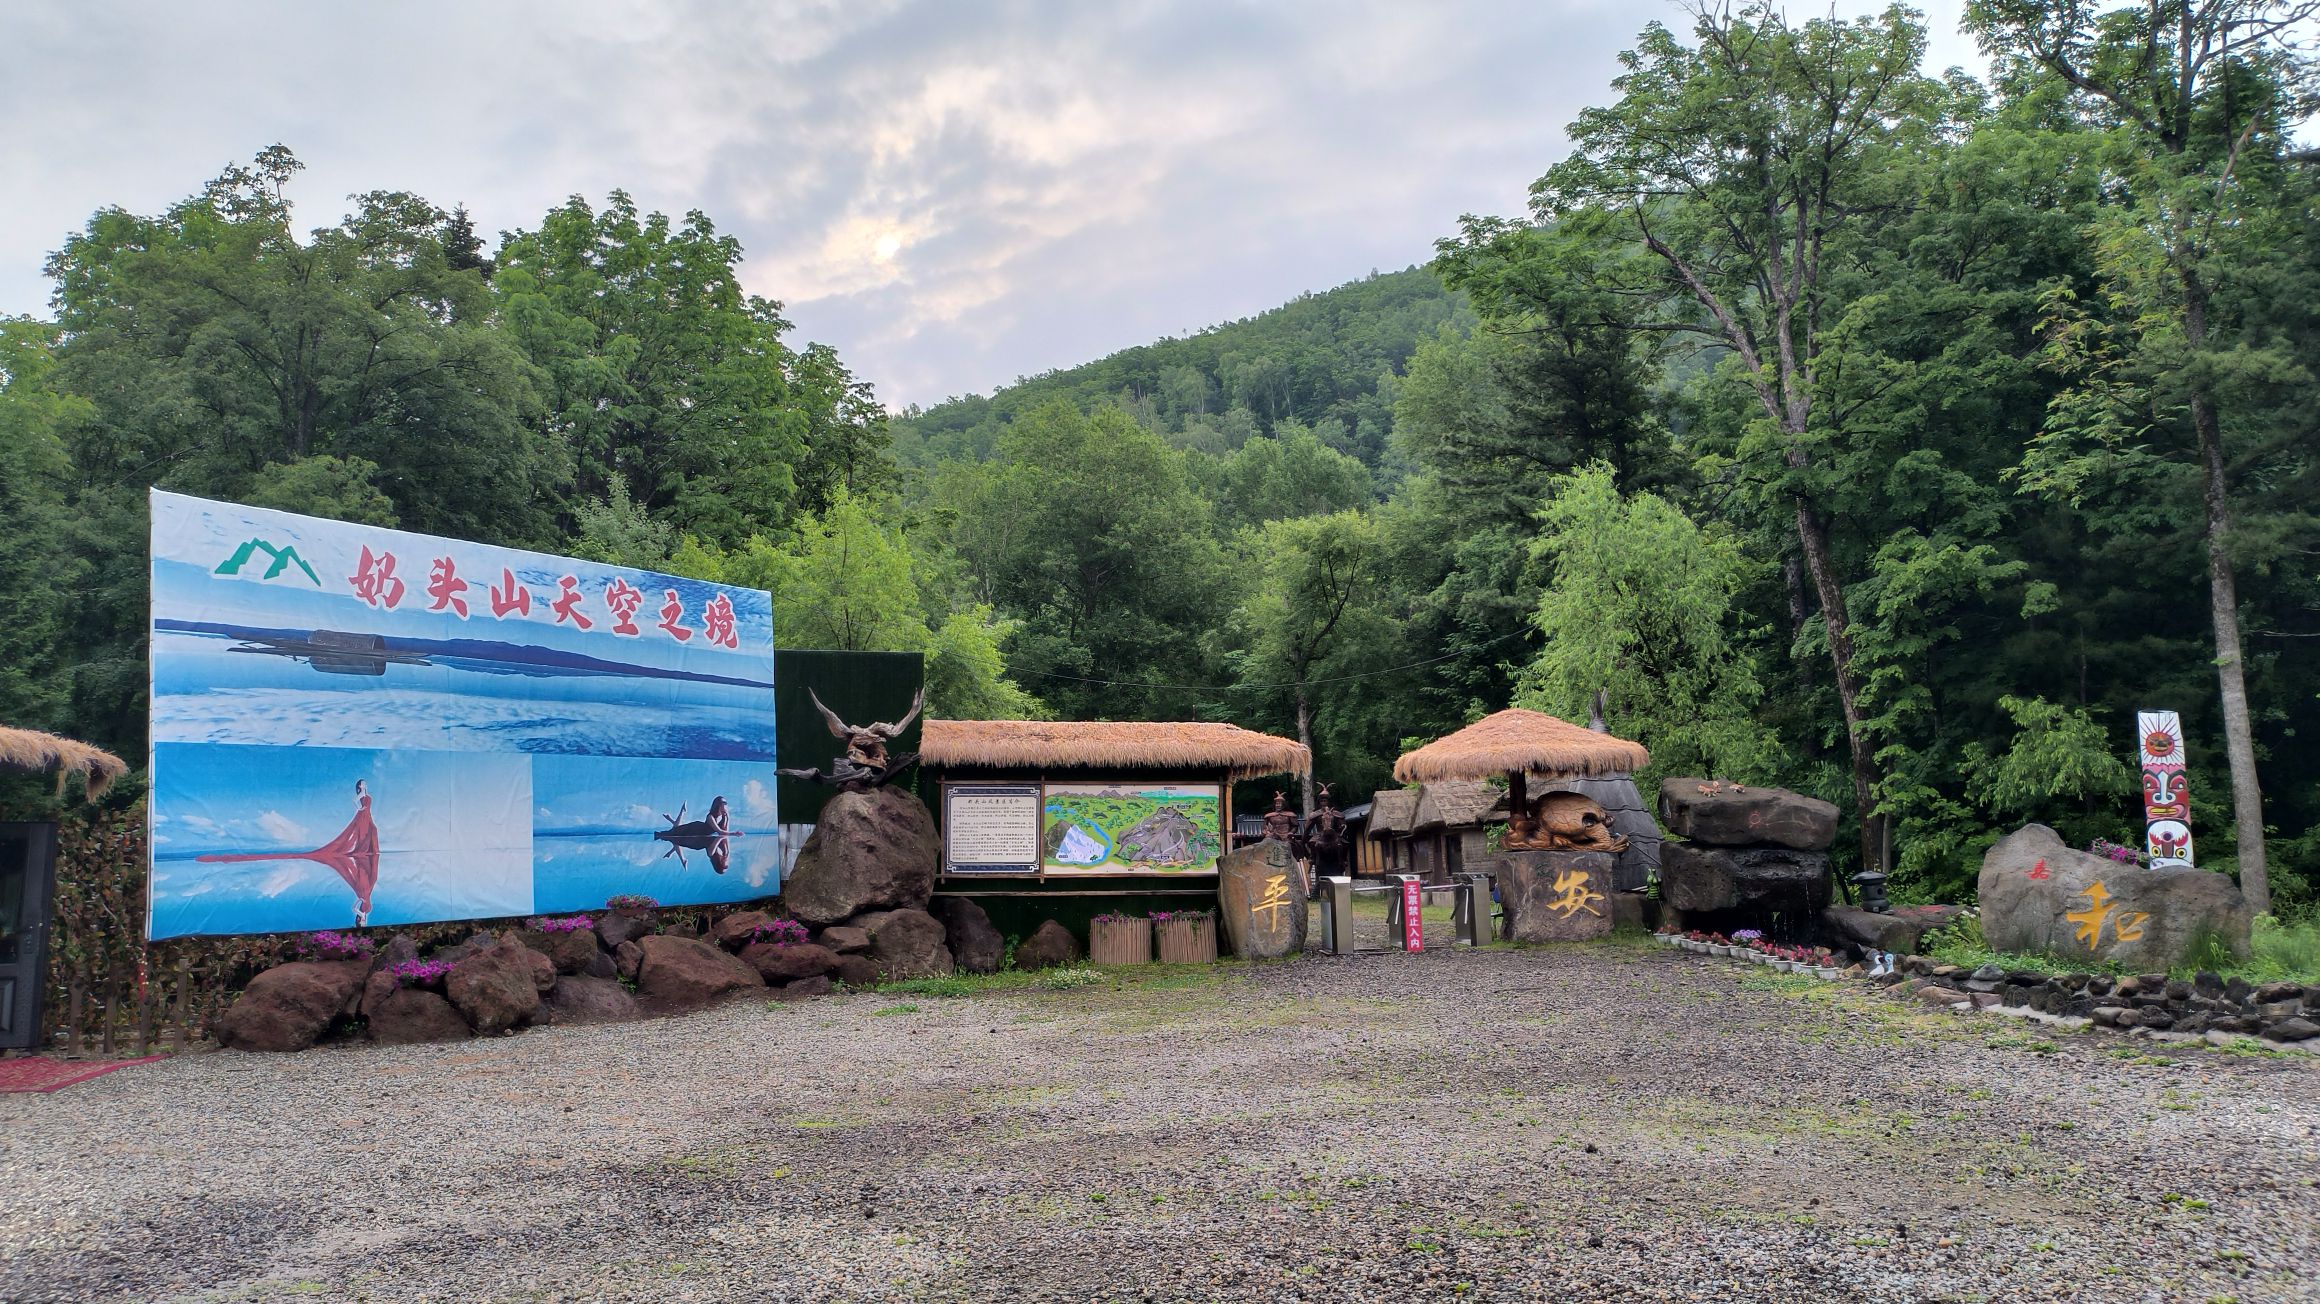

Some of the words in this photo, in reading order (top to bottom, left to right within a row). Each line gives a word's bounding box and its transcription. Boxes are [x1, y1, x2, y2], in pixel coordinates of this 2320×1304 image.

[348, 544, 738, 649] 奶头山天空之境
[1252, 874, 1292, 933] 平
[1407, 885, 1420, 948] 无票禁止入内
[1546, 870, 1605, 920] 安
[2065, 880, 2150, 951] 和
